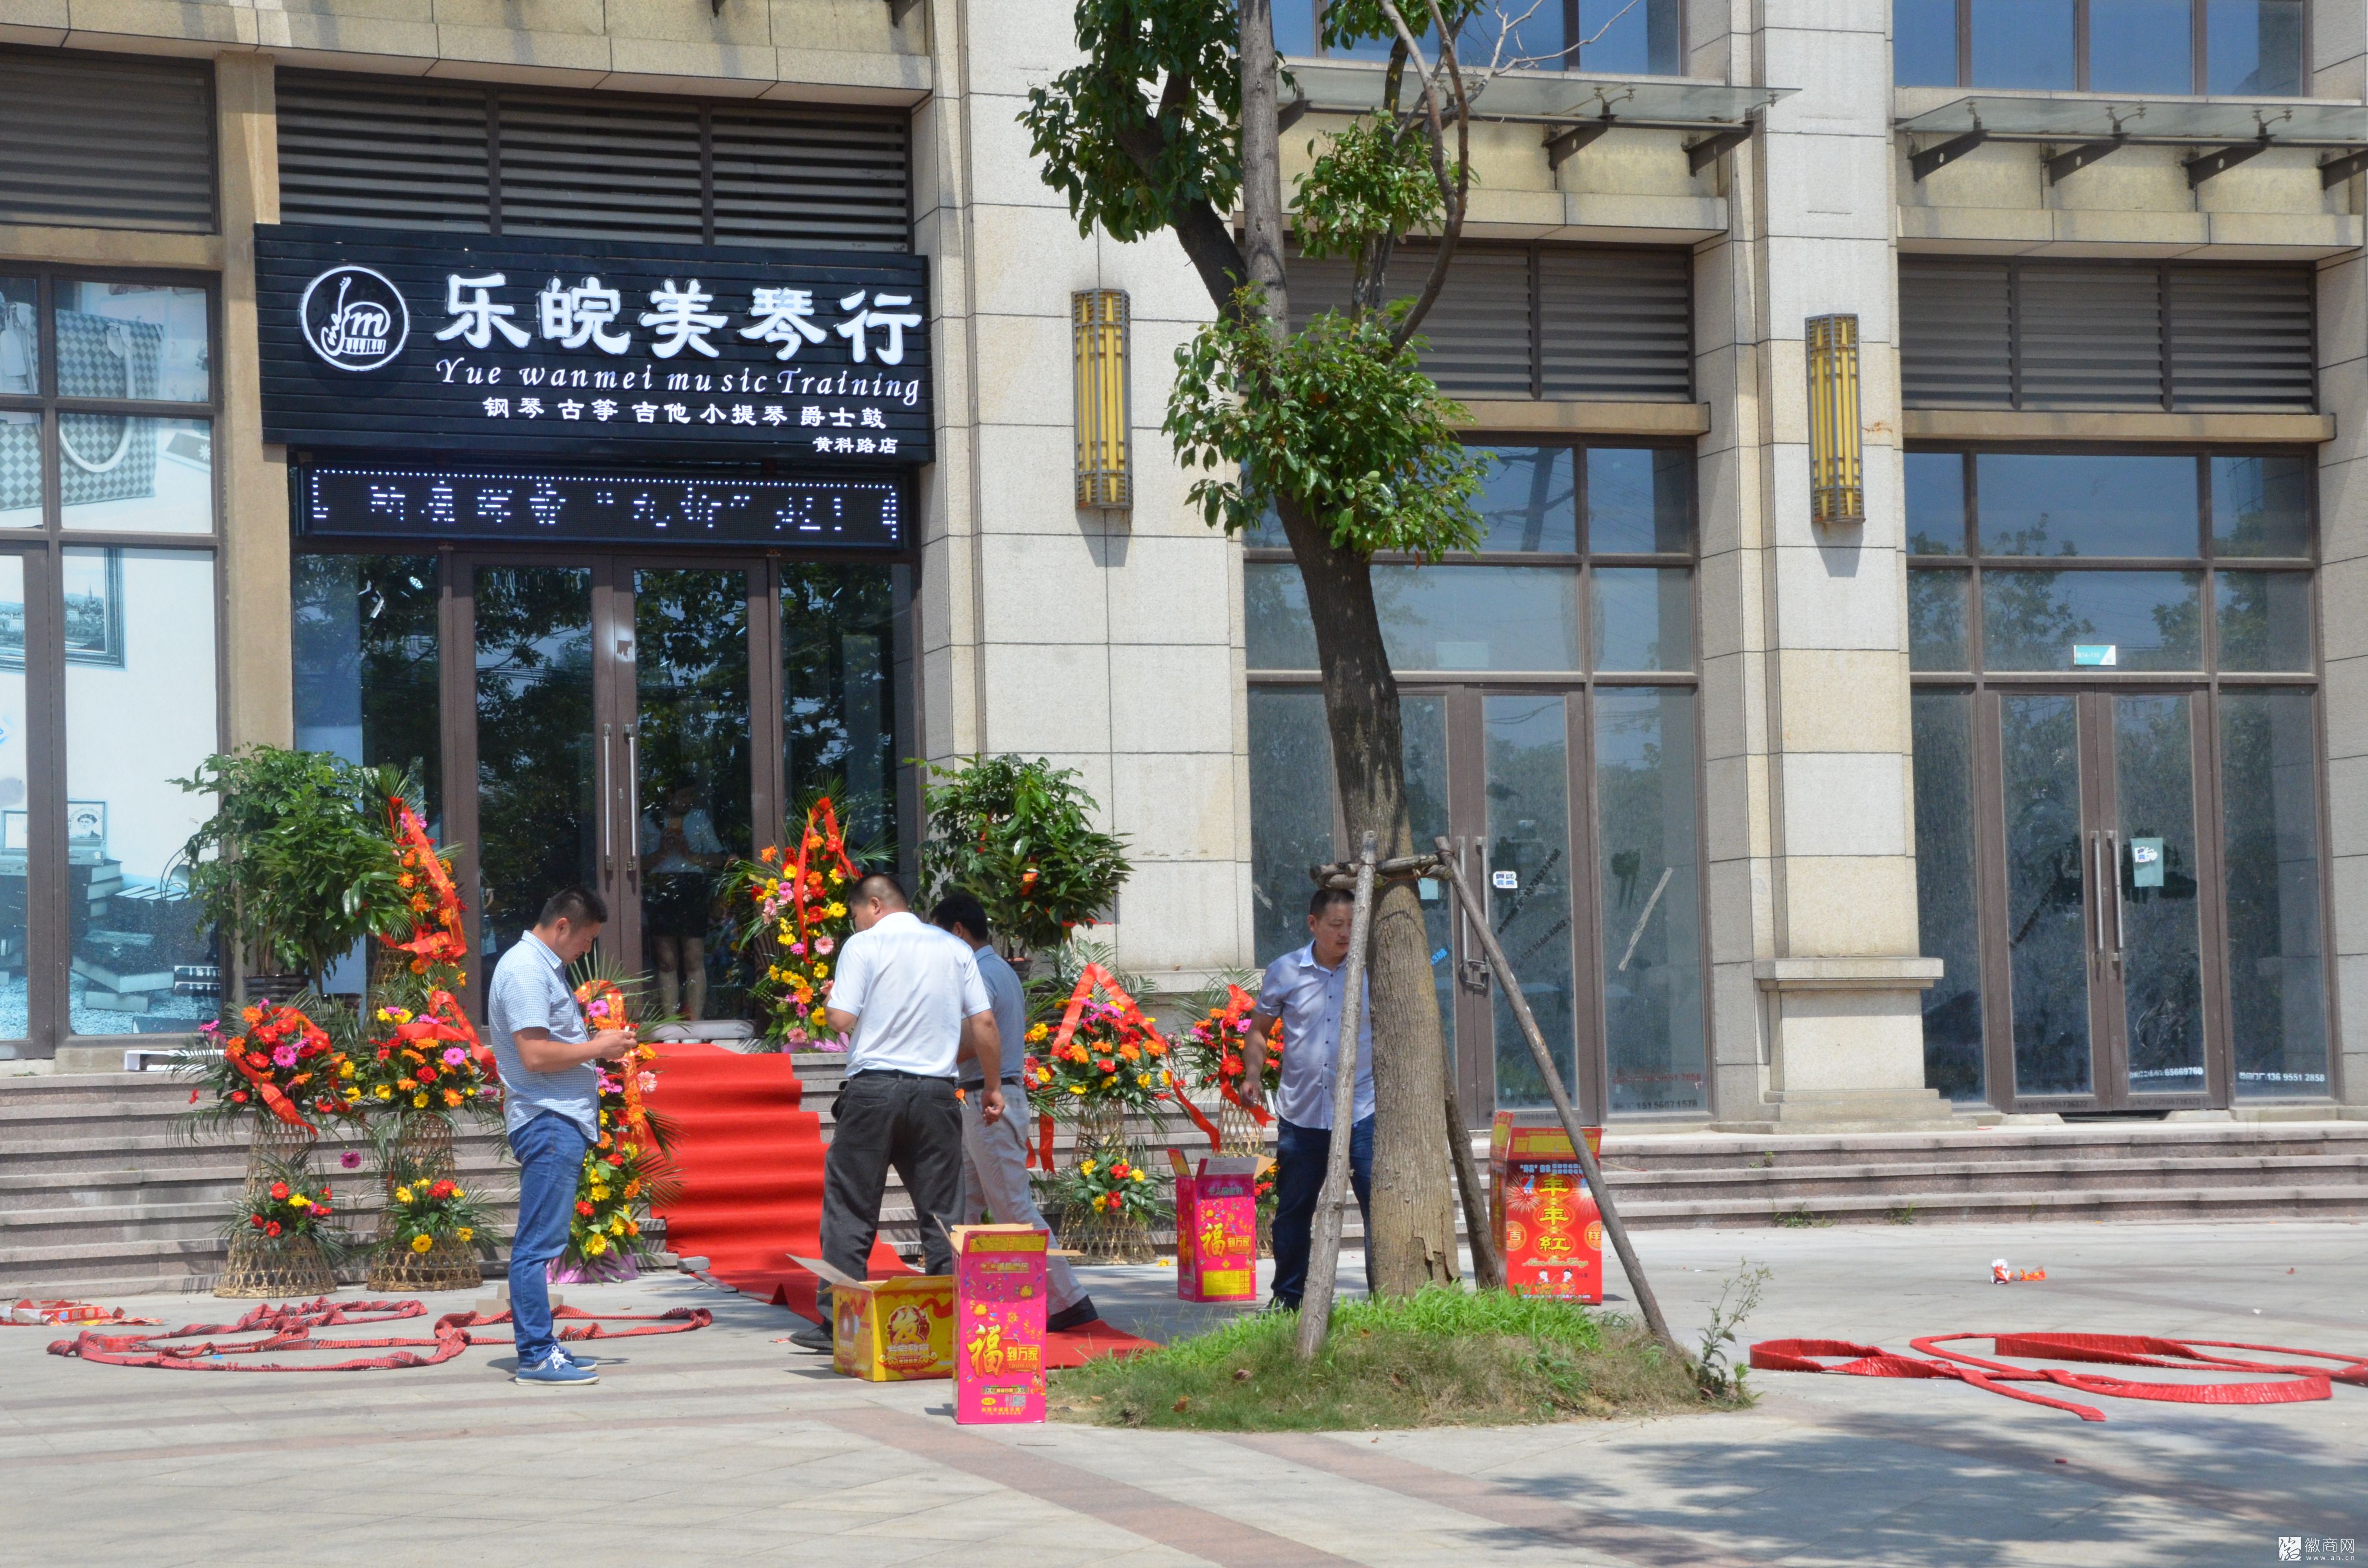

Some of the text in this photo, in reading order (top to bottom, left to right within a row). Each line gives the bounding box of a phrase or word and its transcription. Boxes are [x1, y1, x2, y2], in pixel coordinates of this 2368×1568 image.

[434, 273, 922, 365] 乐皖美琴行
[436, 357, 919, 406] Yue wanmei music Training
[812, 436, 898, 453] 黄科路店
[1431, 948, 1447, 965] 388
[2164, 1067, 2204, 1076] 65669760
[2283, 1073, 2302, 1081] 9551
[2305, 1074, 2326, 1082] 2858
[1200, 1223, 1225, 1259] 福
[1510, 1230, 1521, 1241] 吉
[967, 1324, 1038, 1377] 福 到万家
